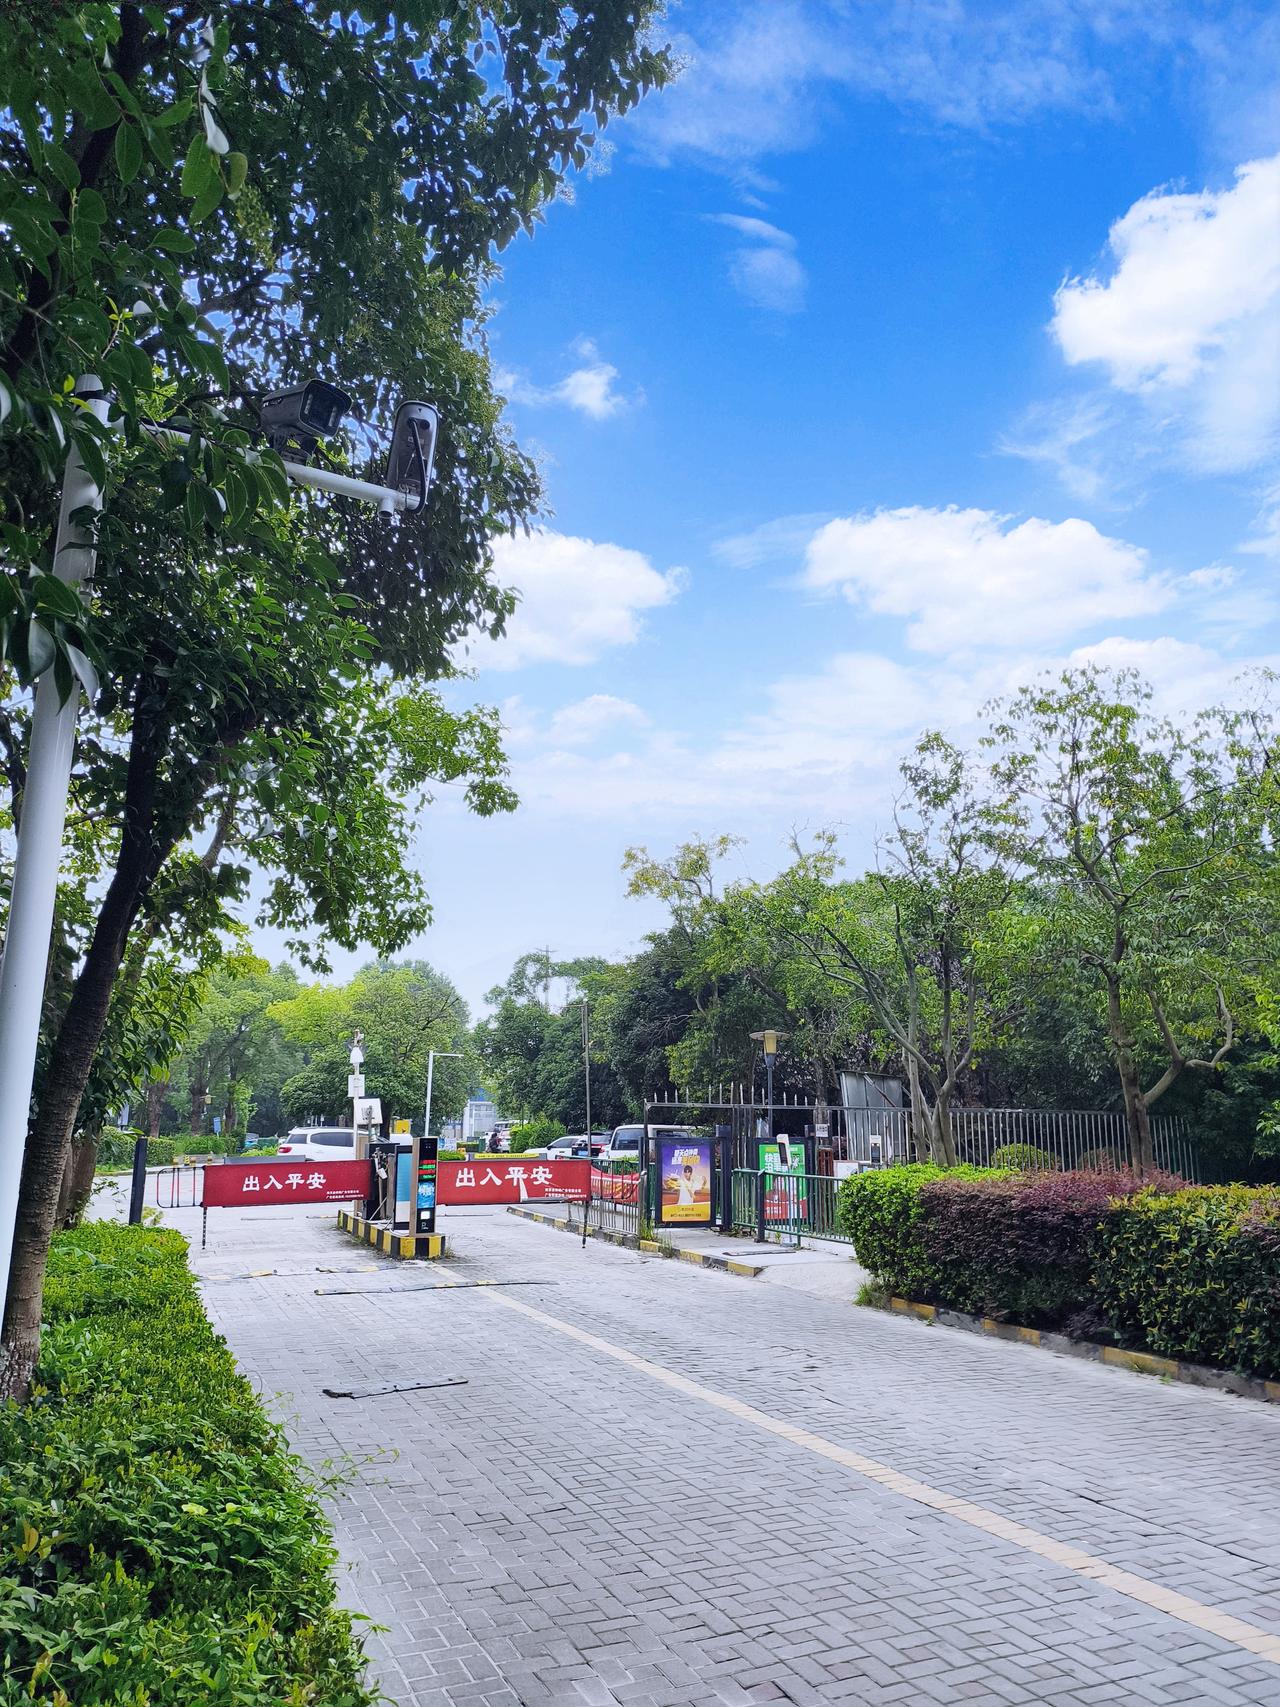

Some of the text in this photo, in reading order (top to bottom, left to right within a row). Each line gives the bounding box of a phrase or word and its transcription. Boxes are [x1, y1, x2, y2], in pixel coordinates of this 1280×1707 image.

[242, 1172, 326, 1191] 出入平安
[456, 1166, 552, 1187] 出入平安
